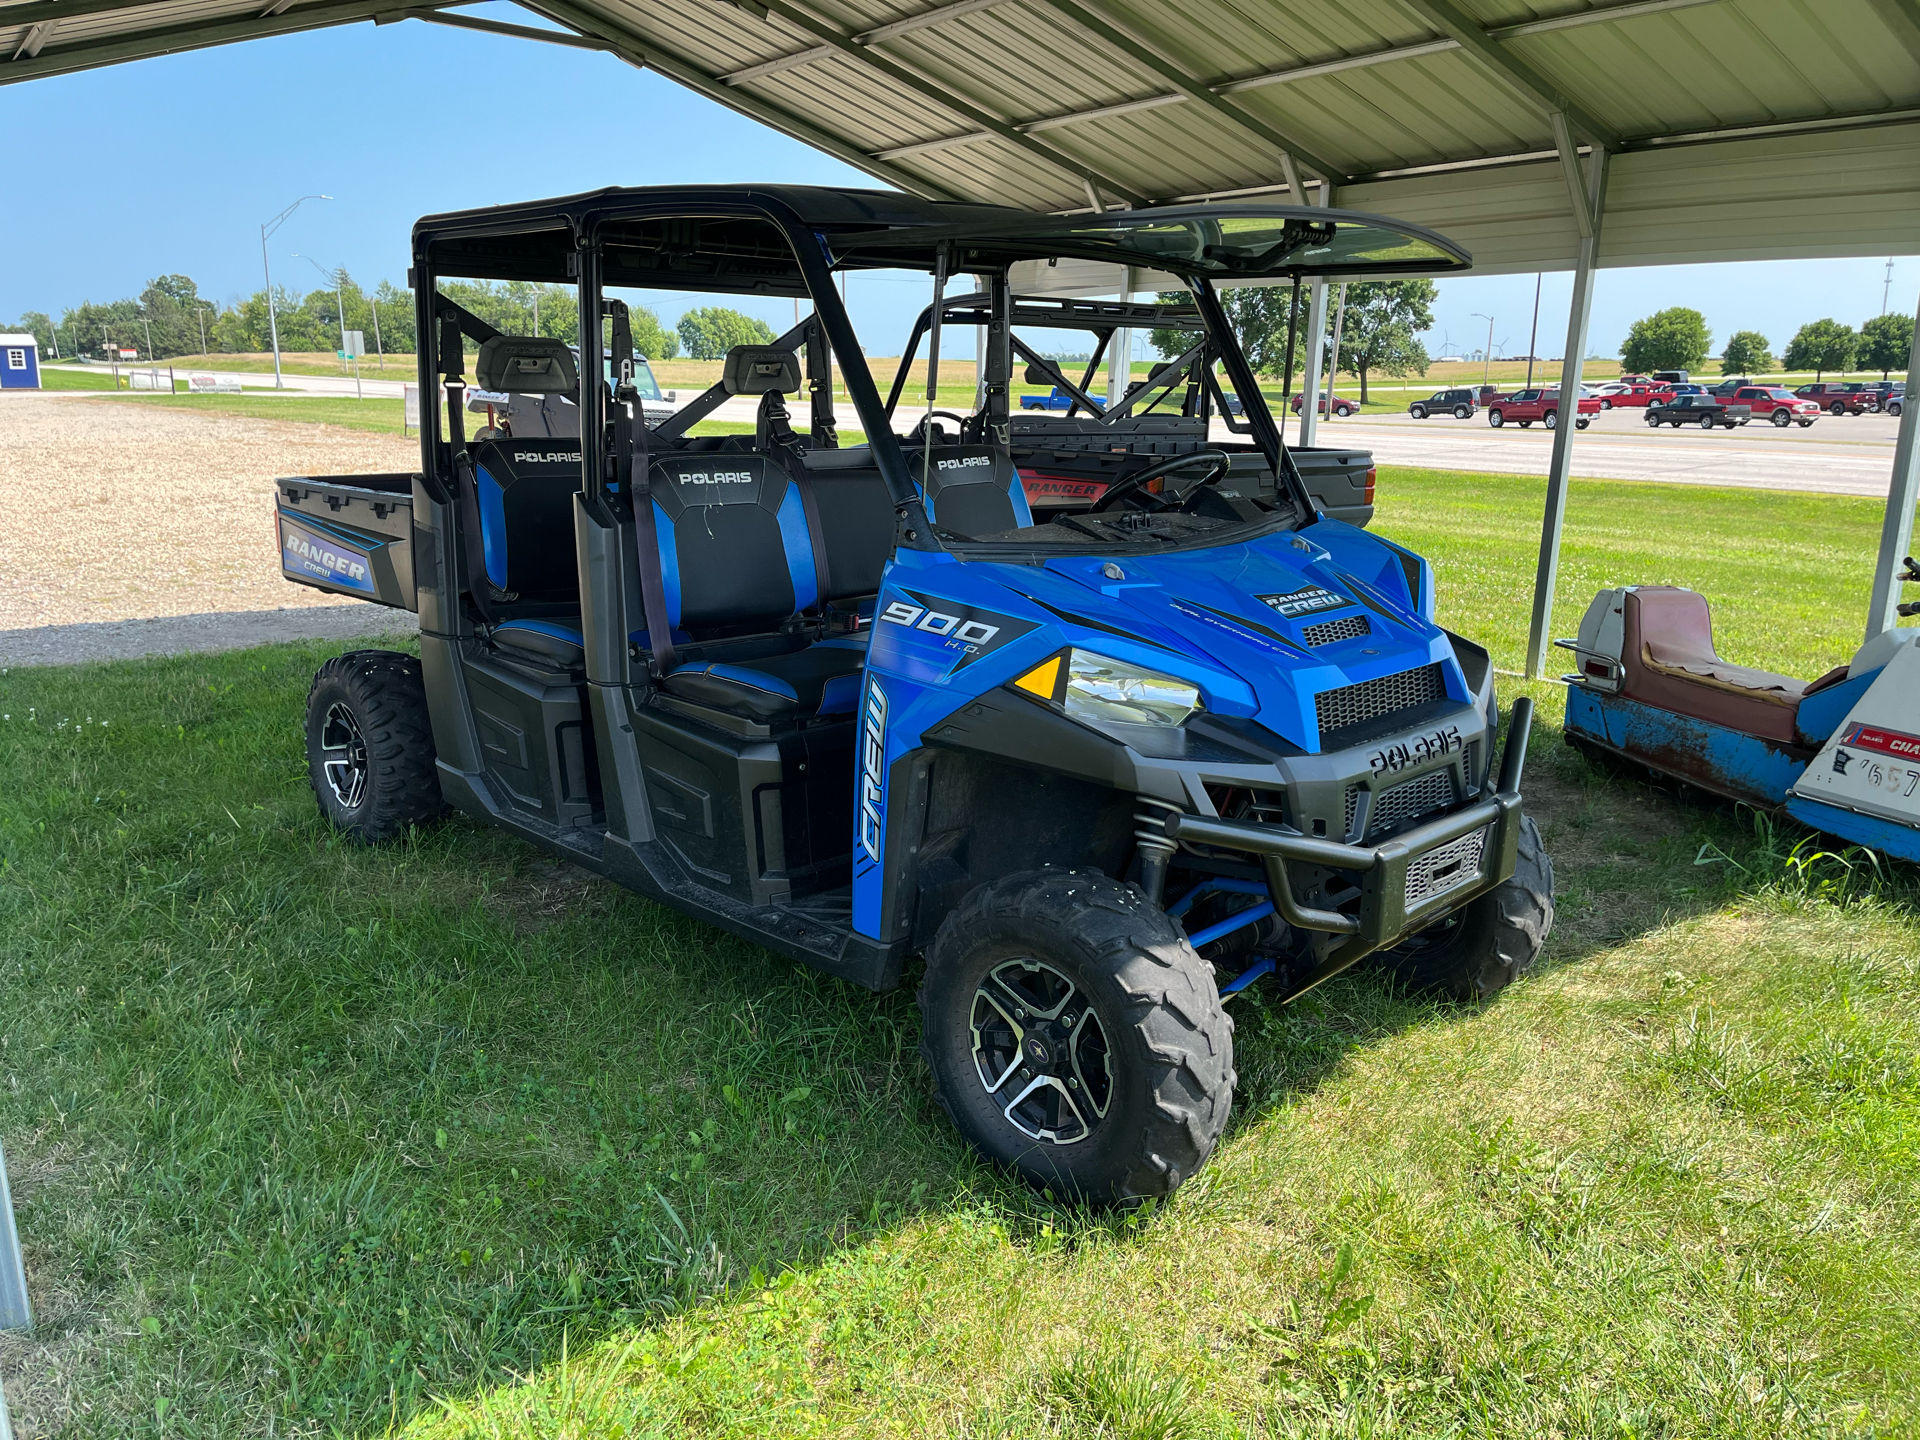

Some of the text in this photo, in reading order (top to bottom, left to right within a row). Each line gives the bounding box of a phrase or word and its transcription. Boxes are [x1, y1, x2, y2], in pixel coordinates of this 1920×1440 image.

[505, 346, 561, 355] RANGER
[514, 452, 582, 463] POLARIS
[937, 456, 990, 471] POLARIS
[679, 472, 752, 485] POLARIS
[1028, 483, 1098, 495] RANGER
[286, 534, 365, 581] RANGER
[303, 561, 331, 578] CREW
[1266, 589, 1329, 606] RANGER
[1277, 594, 1344, 615] CREW
[880, 601, 1000, 646] 900
[1169, 603, 1201, 618] DUAL
[1204, 617, 1270, 647] OVERHEAD
[944, 640, 980, 655] H.O.
[1367, 724, 1463, 780] POLARIS
[1862, 734, 1920, 756] POLARIS CHA
[862, 680, 888, 864] CREW
